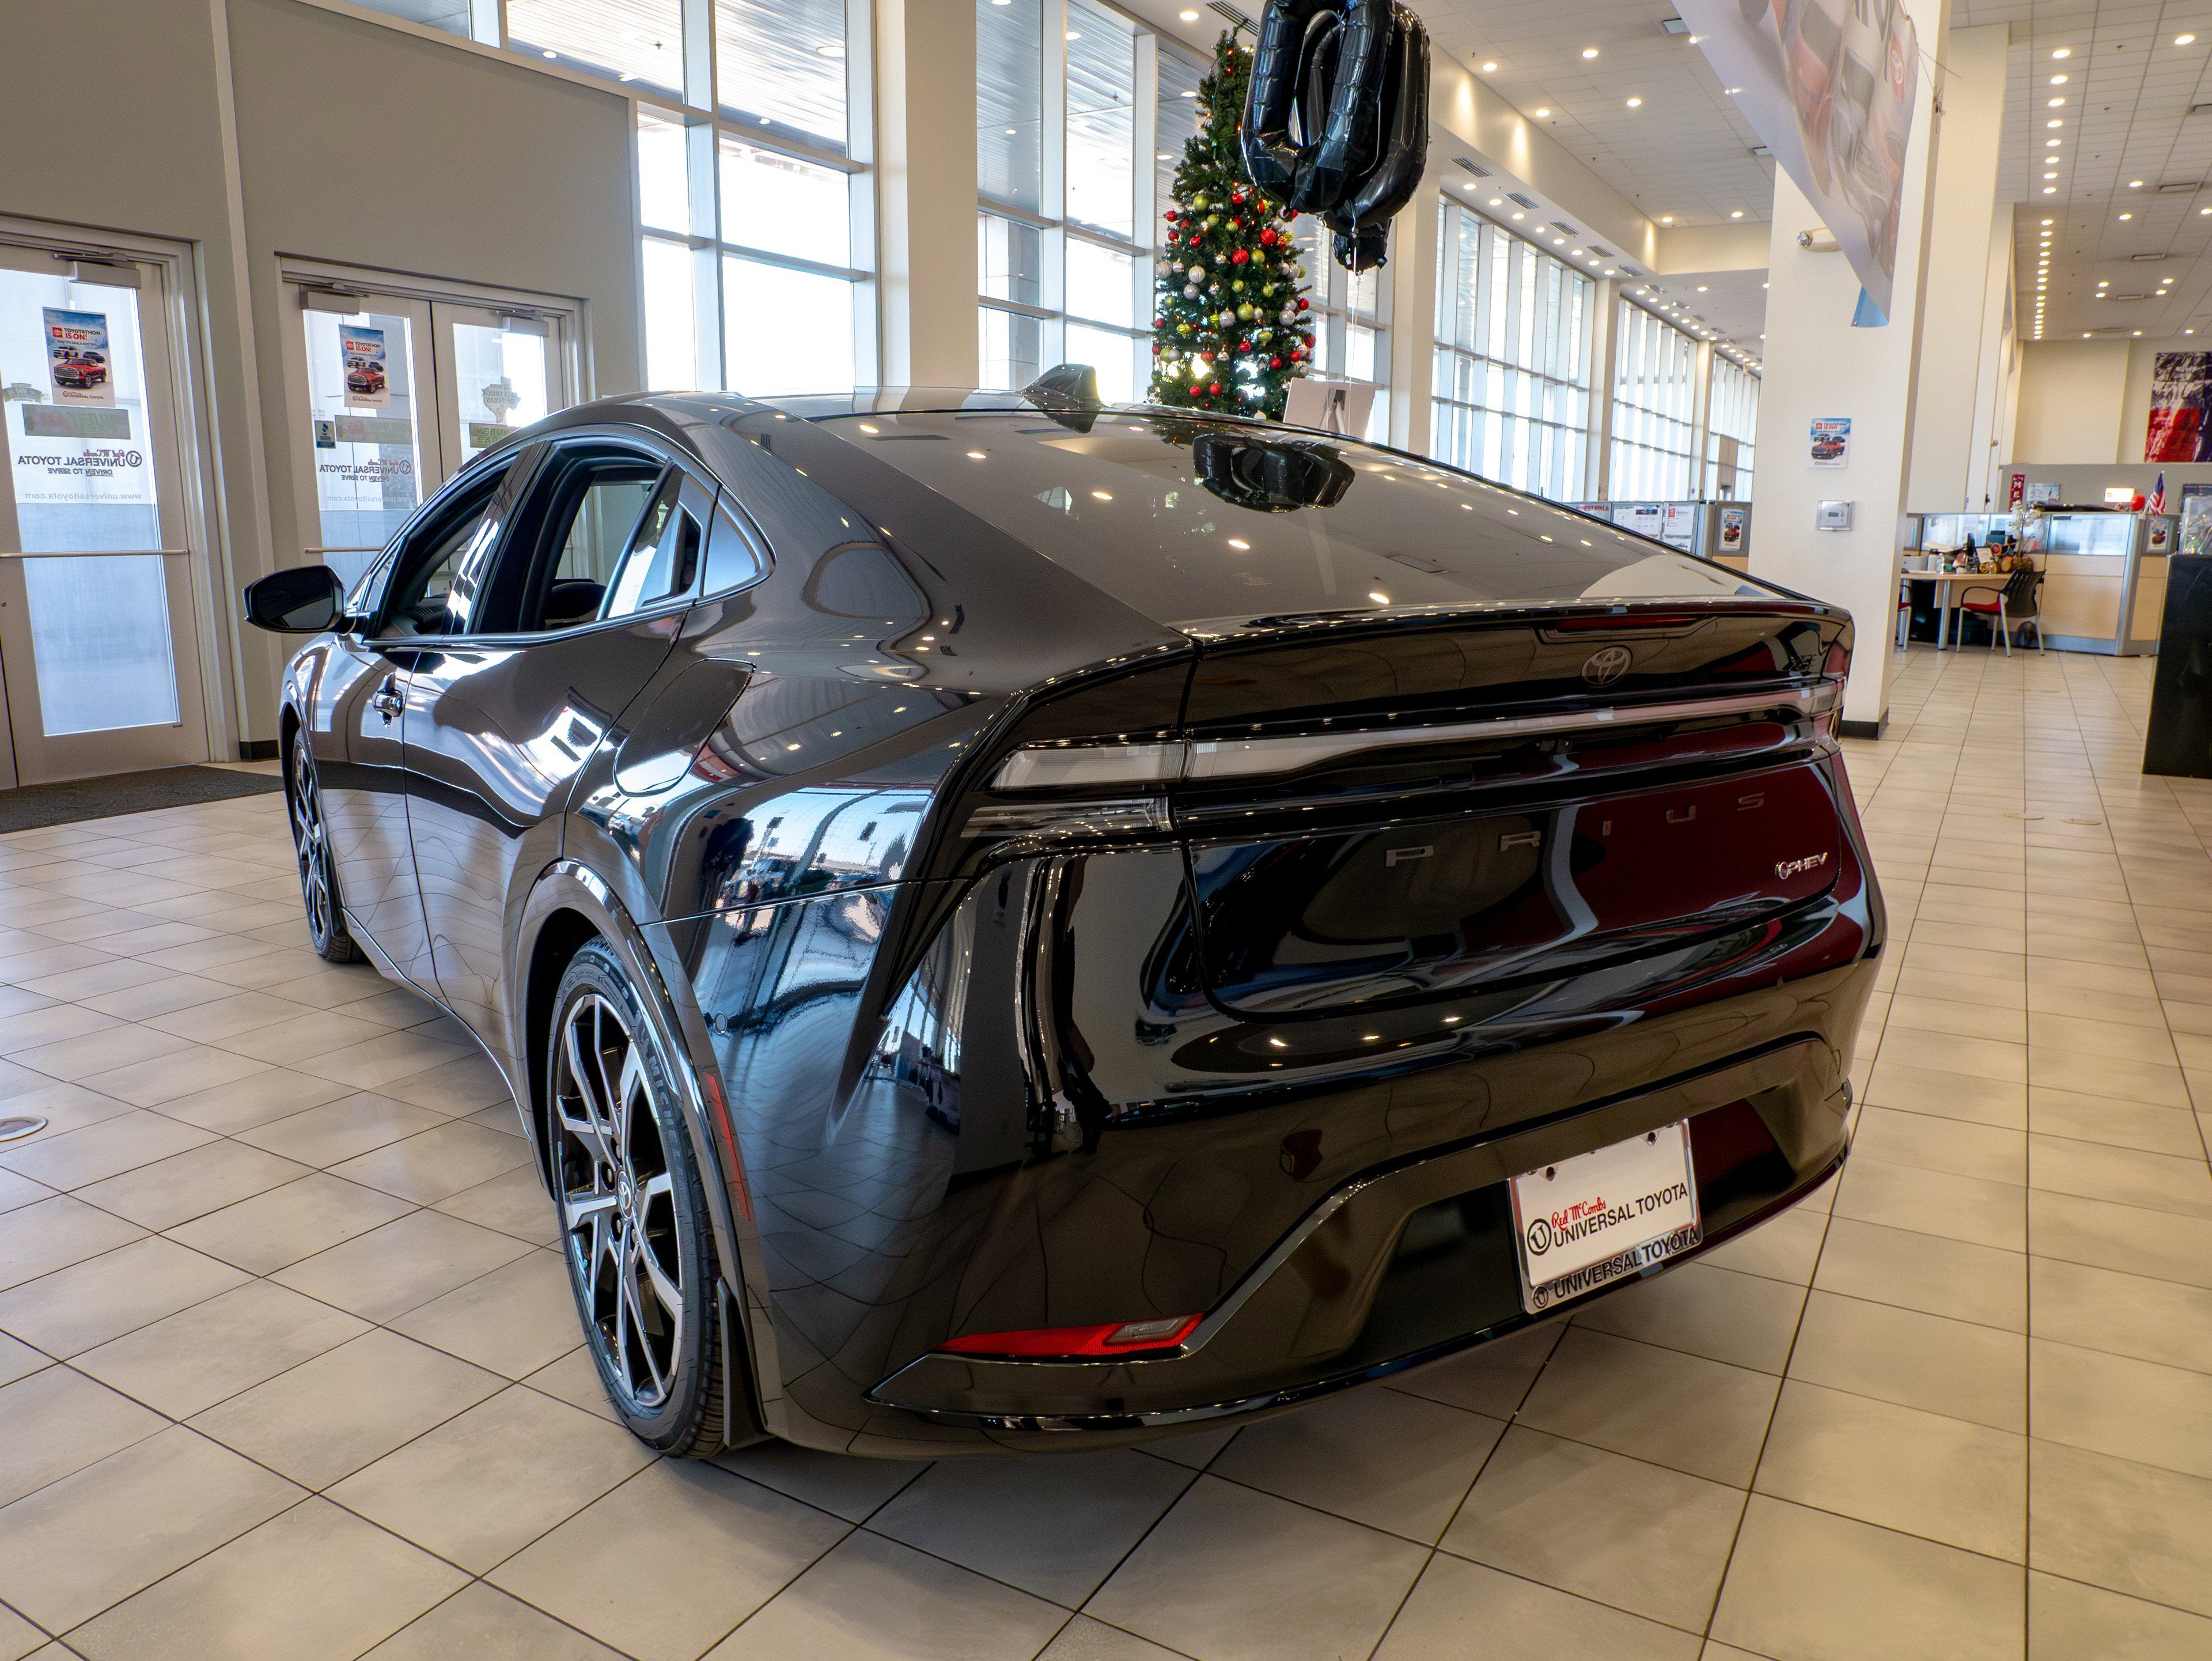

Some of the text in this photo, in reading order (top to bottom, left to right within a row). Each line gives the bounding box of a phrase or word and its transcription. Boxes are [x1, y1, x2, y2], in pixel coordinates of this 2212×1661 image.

[1386, 793, 1766, 867] PRIUS
[1788, 852, 1828, 875] PHEV
[1551, 1197, 1607, 1231] Red McCombs
[1554, 1204, 1636, 1248] UNIVERSAL
[1635, 1182, 1688, 1214] TOYOTA
[1554, 1249, 1642, 1299] UNIVERSAL
[1642, 1227, 1698, 1264] TOYOTA
